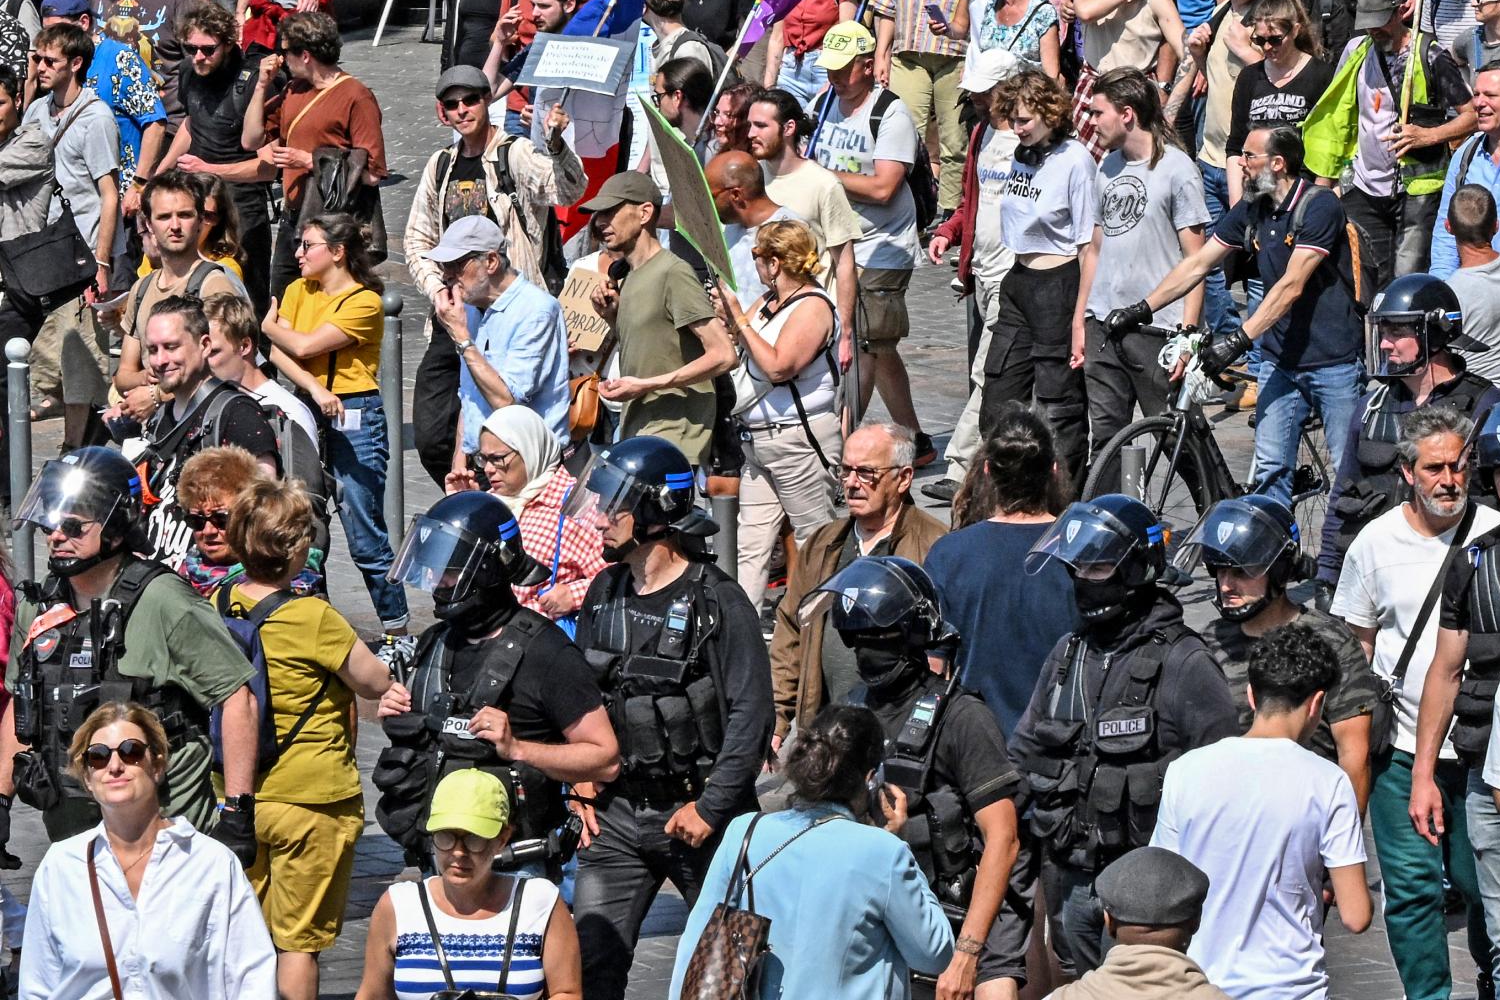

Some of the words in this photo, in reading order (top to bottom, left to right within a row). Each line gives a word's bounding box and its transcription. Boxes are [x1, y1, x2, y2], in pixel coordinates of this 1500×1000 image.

[1007, 182, 1042, 203] MAIDEN
[72, 656, 91, 665] POLI
[444, 720, 469, 731] POL
[1102, 720, 1142, 734] POLICE
